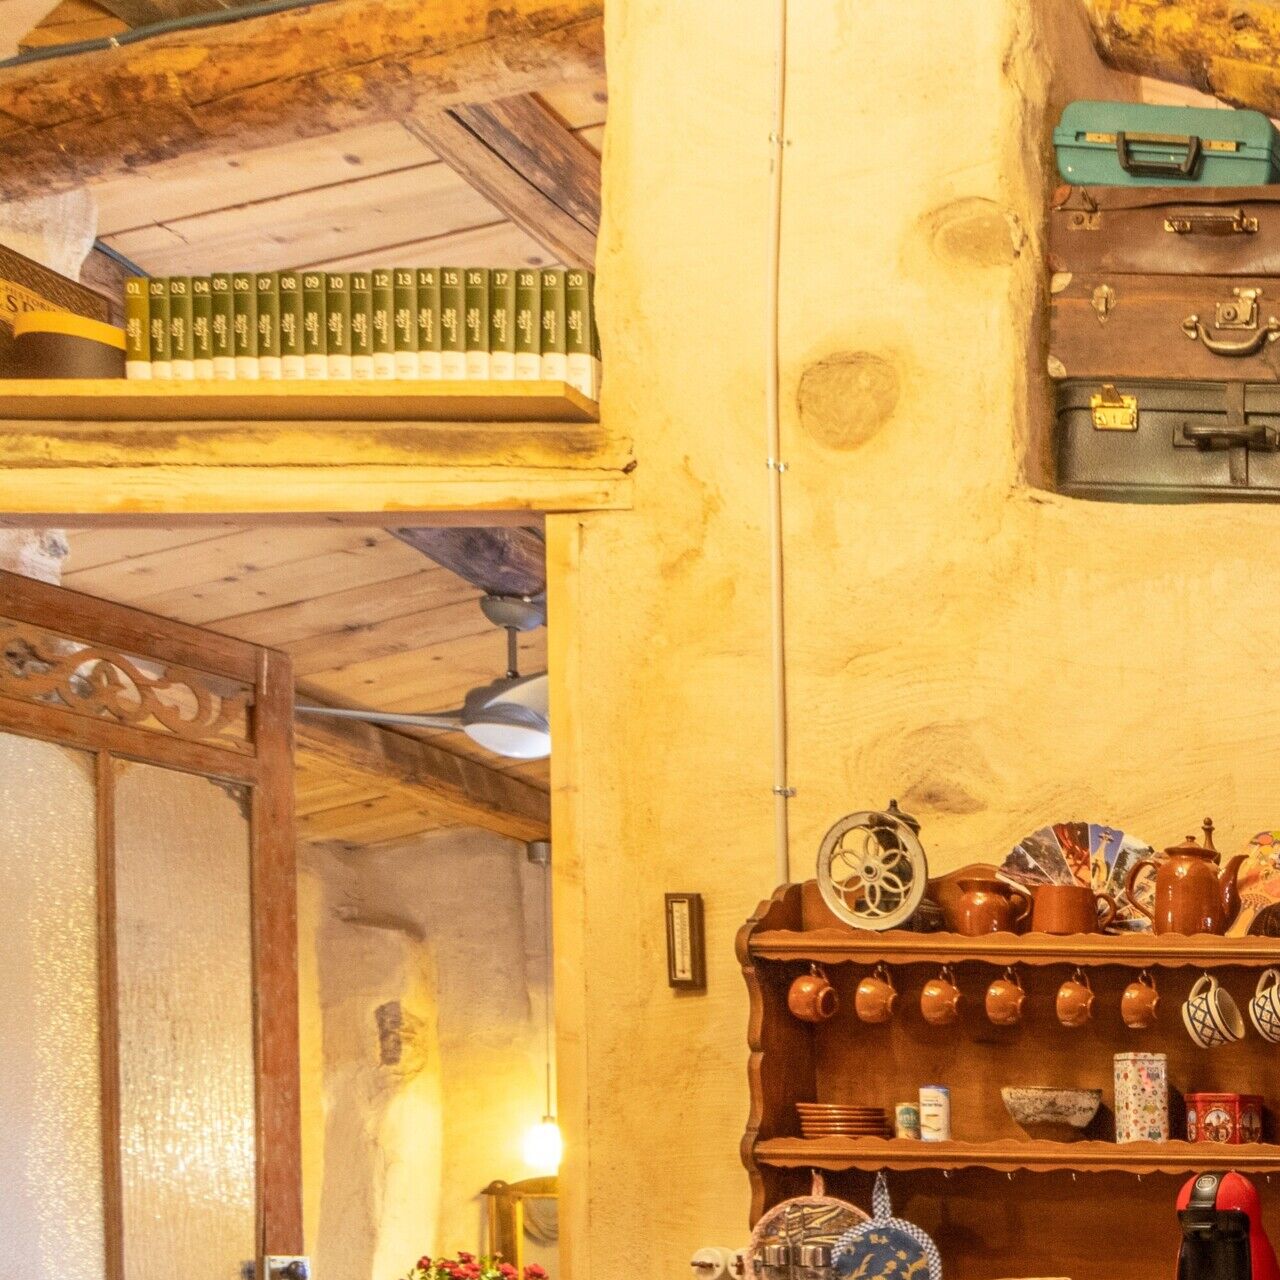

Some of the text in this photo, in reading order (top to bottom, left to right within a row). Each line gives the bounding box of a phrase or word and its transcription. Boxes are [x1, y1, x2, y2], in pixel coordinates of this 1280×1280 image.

[214, 278, 227, 290] 05
[234, 278, 248, 290] 06
[258, 278, 271, 290] 07
[282, 277, 296, 290] 08
[305, 277, 319, 289] 09
[330, 277, 343, 289] 10
[354, 278, 365, 290] 11
[375, 274, 388, 286] 12
[398, 273, 411, 285] 13
[420, 273, 433, 285] 14
[445, 272, 458, 284] 15
[469, 272, 481, 284] 16
[496, 273, 507, 285] 17
[521, 274, 533, 286] 18
[544, 274, 556, 286] 19
[568, 274, 582, 286] 20
[127, 282, 140, 295] 01
[151, 283, 163, 296] 02
[171, 281, 185, 294] 03
[195, 280, 209, 293] 04
